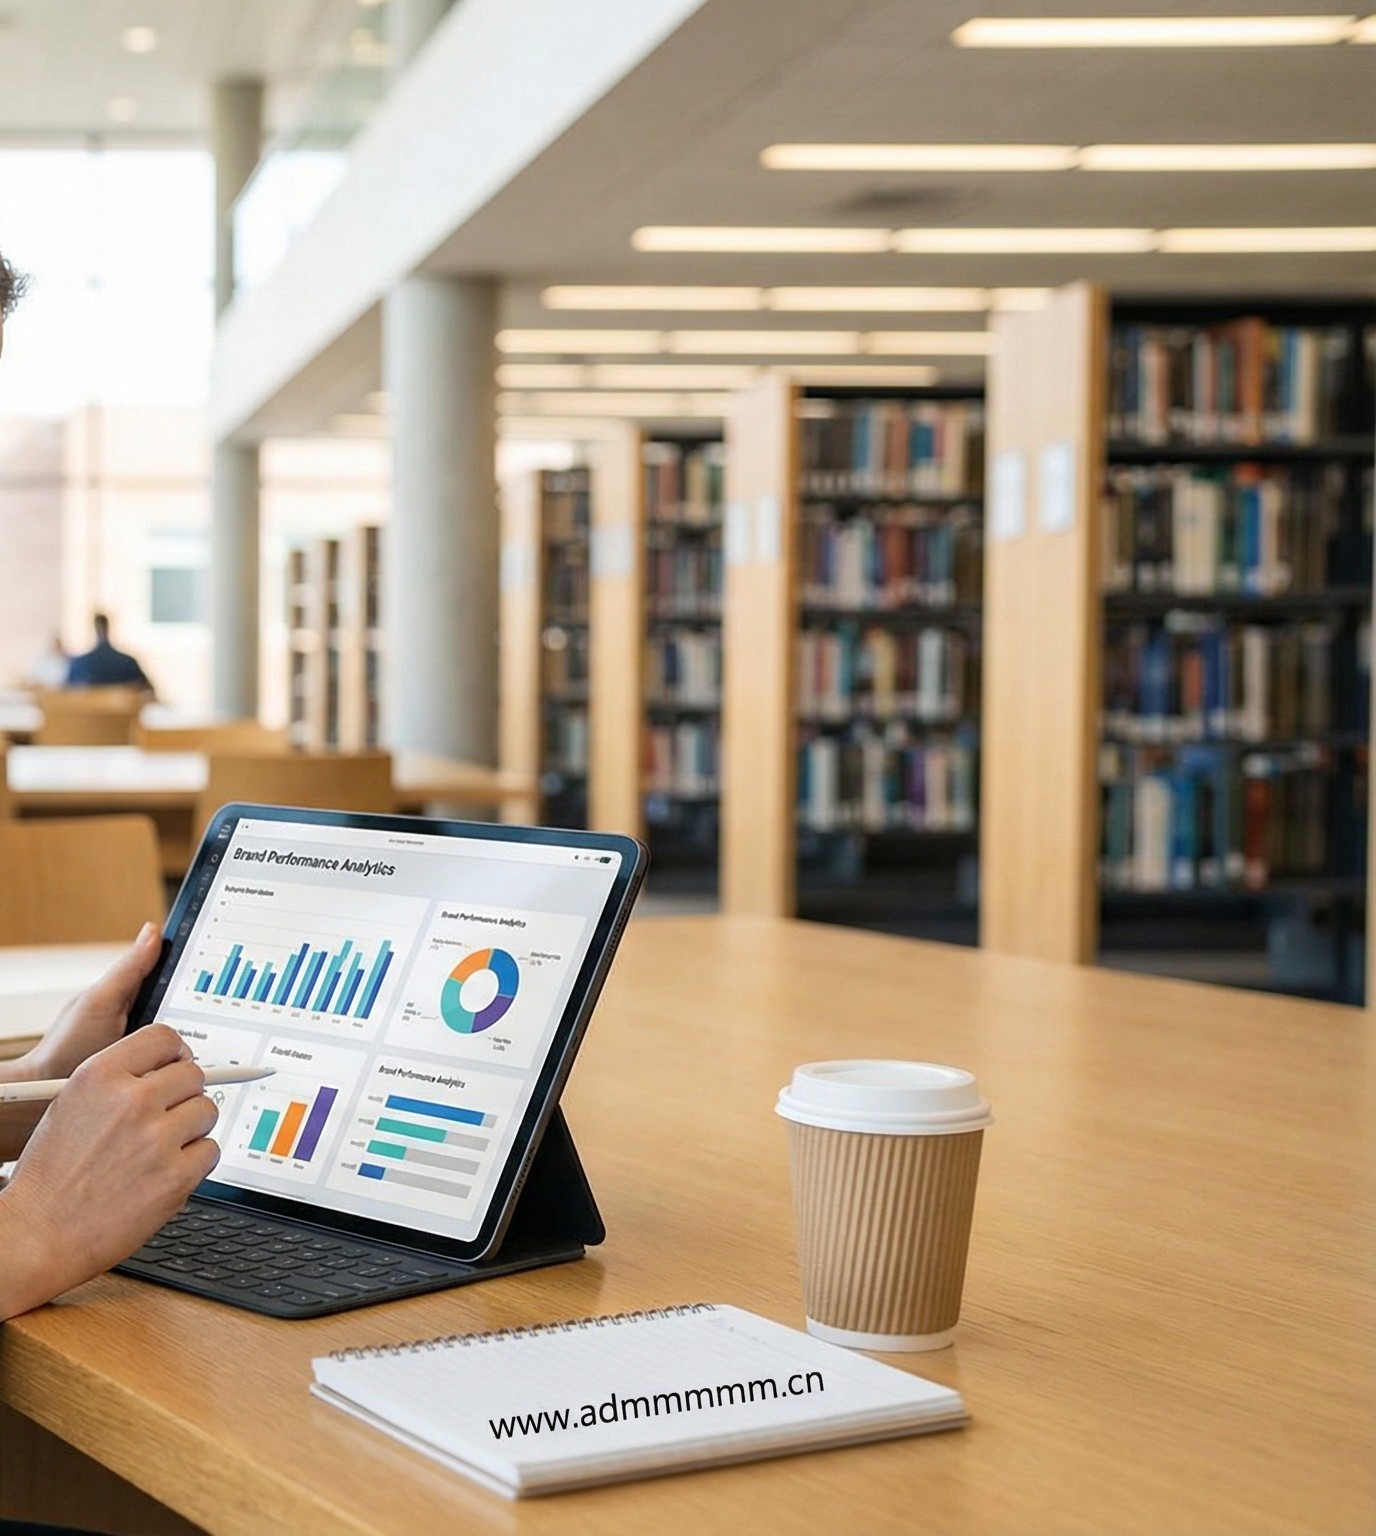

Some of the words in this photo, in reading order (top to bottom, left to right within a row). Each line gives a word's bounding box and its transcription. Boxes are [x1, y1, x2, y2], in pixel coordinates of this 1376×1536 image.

[233, 847, 268, 863] Brand
[266, 850, 340, 871] Performance
[340, 858, 396, 877] Analytics
[489, 1370, 825, 1440] www.admmmmm.cn
